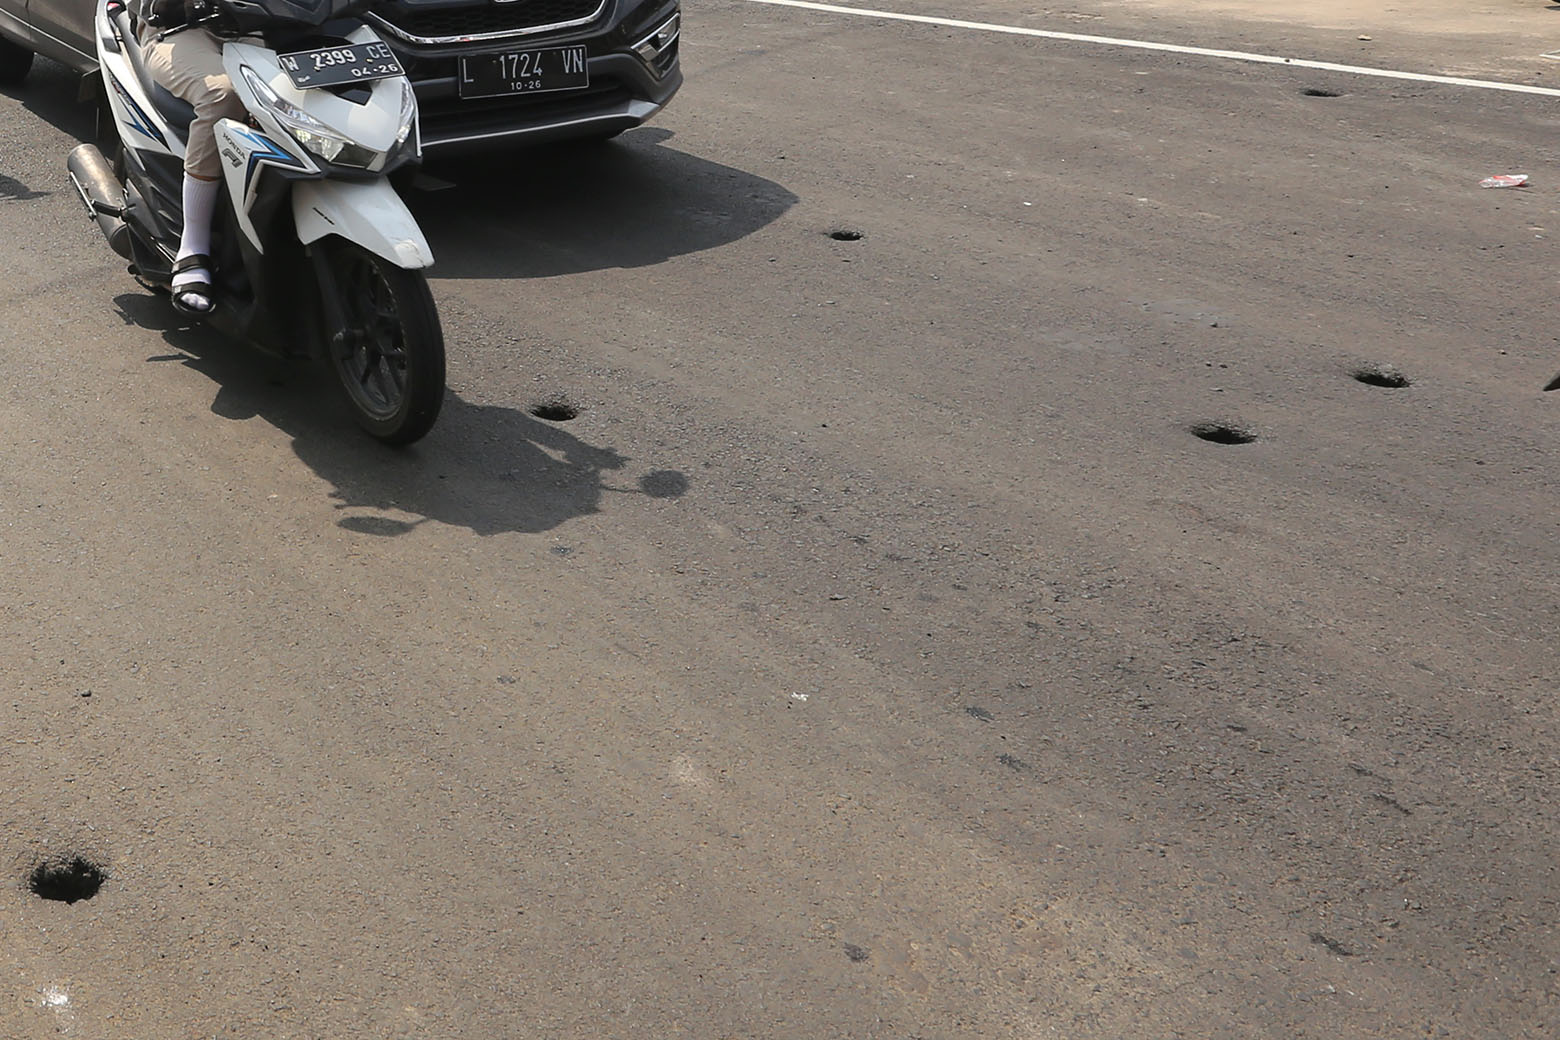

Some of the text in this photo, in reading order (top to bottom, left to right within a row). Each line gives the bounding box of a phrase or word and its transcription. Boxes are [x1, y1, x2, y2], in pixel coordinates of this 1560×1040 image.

[281, 43, 392, 72] W 2399 CE
[463, 48, 584, 83] L 1724 VN
[222, 133, 246, 160] HONDA
